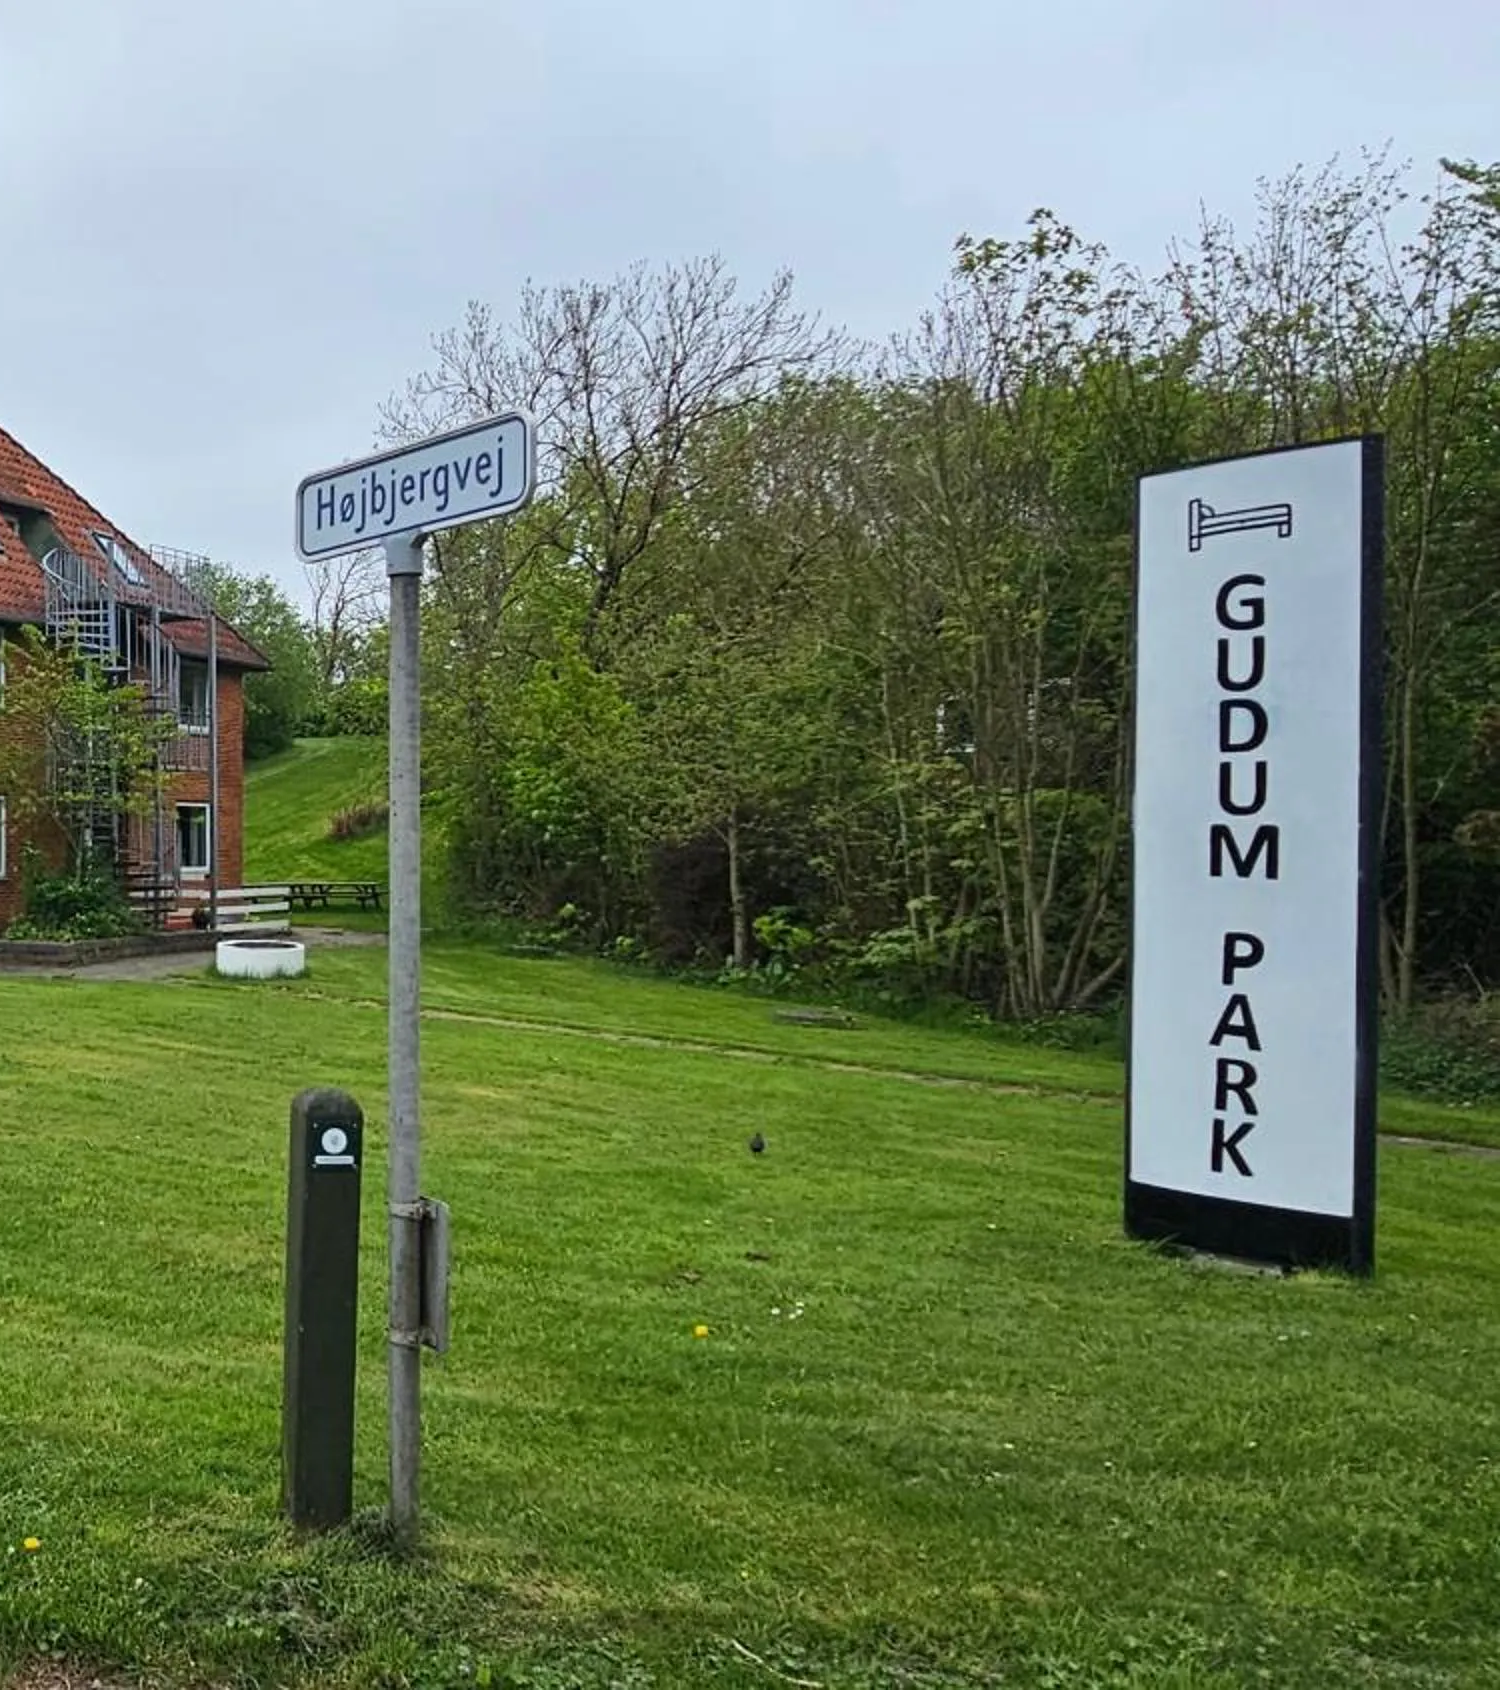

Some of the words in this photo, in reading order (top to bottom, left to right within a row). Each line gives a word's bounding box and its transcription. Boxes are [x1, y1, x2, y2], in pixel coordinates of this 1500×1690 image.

[316, 436, 504, 533] Højbjergvej
[1209, 573, 1280, 880] GUDUM
[1209, 931, 1265, 1176] PARK
